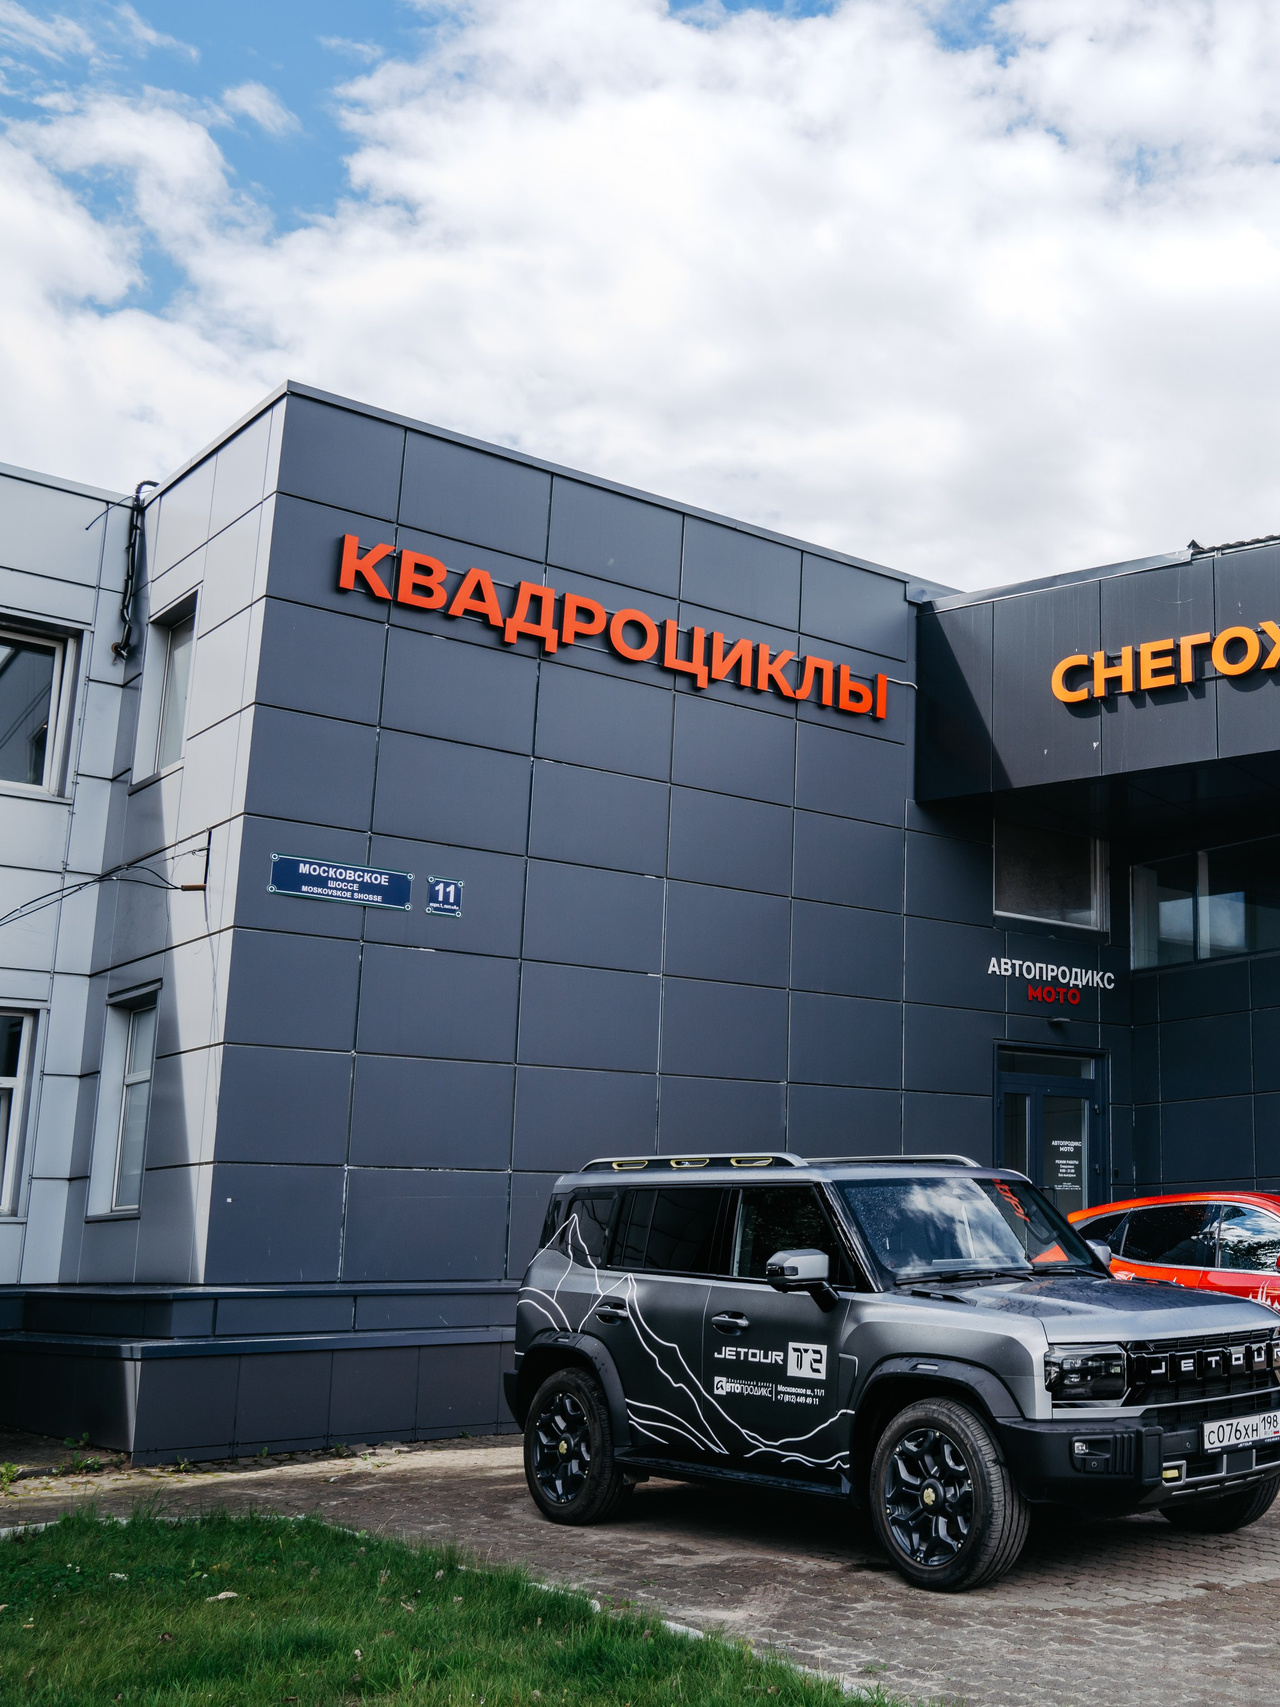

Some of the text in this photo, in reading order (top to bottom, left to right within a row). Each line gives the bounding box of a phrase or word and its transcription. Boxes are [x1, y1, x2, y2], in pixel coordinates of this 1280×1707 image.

[338, 533, 888, 720] КВАДРОЦИКЛЫ
[299, 863, 389, 885] МОСКОВСКОЕ
[301, 885, 383, 902] MOSKOVSKOE SHOSSE
[328, 880, 359, 891] ШОССЕ
[435, 883, 455, 903] 11
[987, 957, 1115, 989] АВТОПРОДИКС
[1028, 984, 1080, 1005] МОТО
[714, 1346, 822, 1374] JETOUR T2
[813, 1397, 819, 1405] 11
[1261, 1414, 1279, 1430] 198
